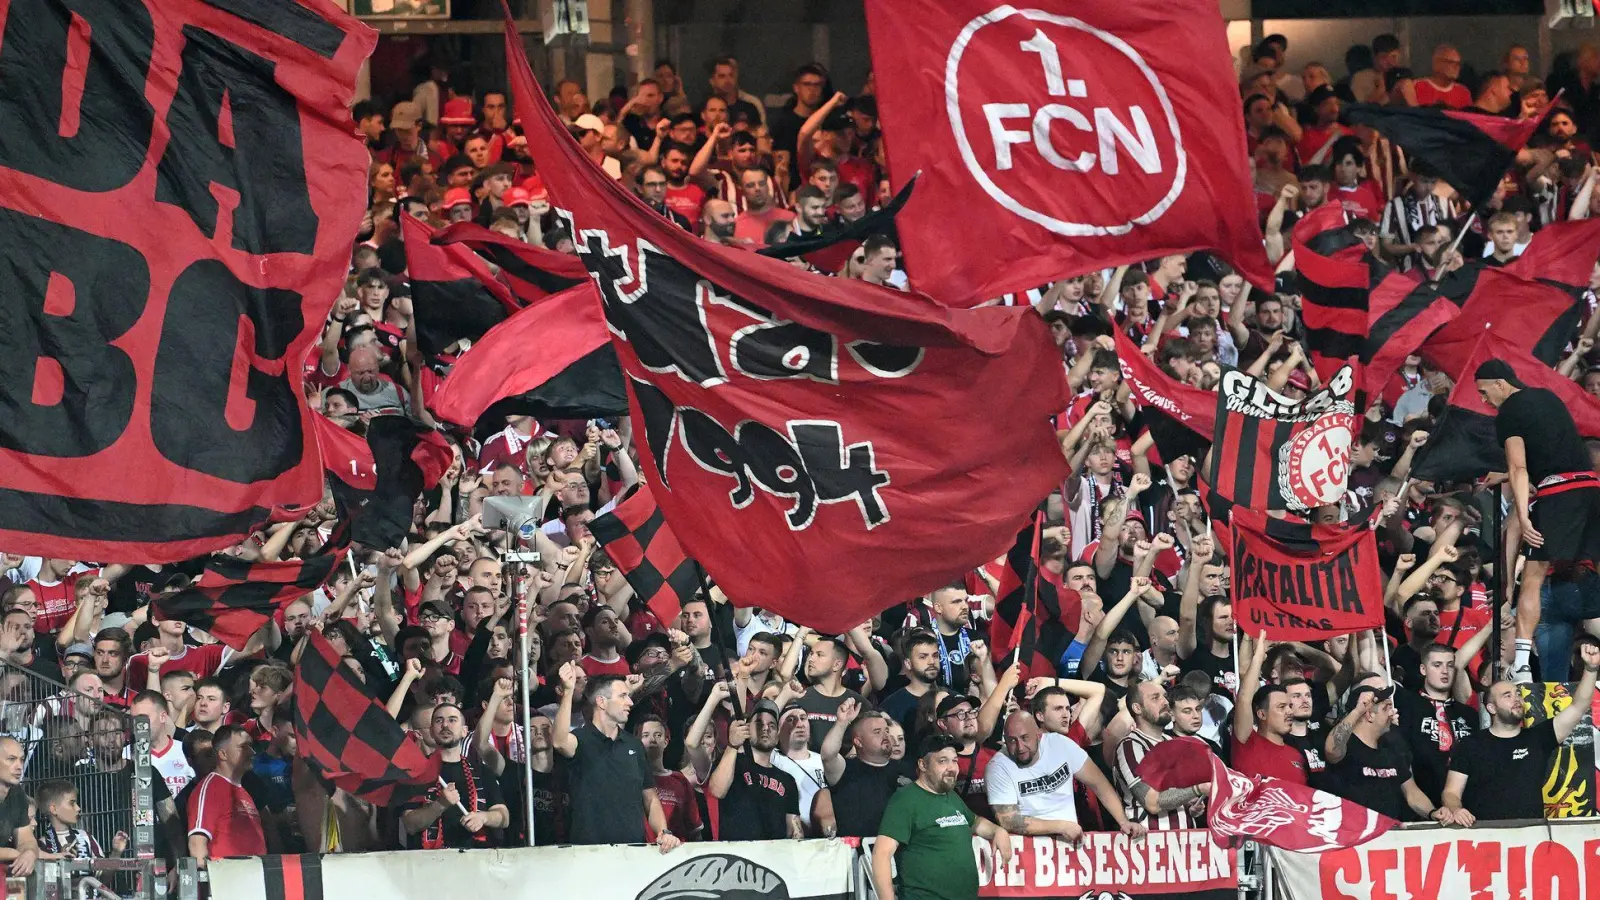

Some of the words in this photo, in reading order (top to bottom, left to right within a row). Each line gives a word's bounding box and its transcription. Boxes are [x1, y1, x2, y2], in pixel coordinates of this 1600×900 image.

[1019, 28, 1087, 98] 1.
[982, 103, 1162, 175] FCN
[1317, 434, 1340, 460] 1.
[1250, 607, 1334, 630] ULTRAS
[1034, 829, 1231, 887] BESESSENEN
